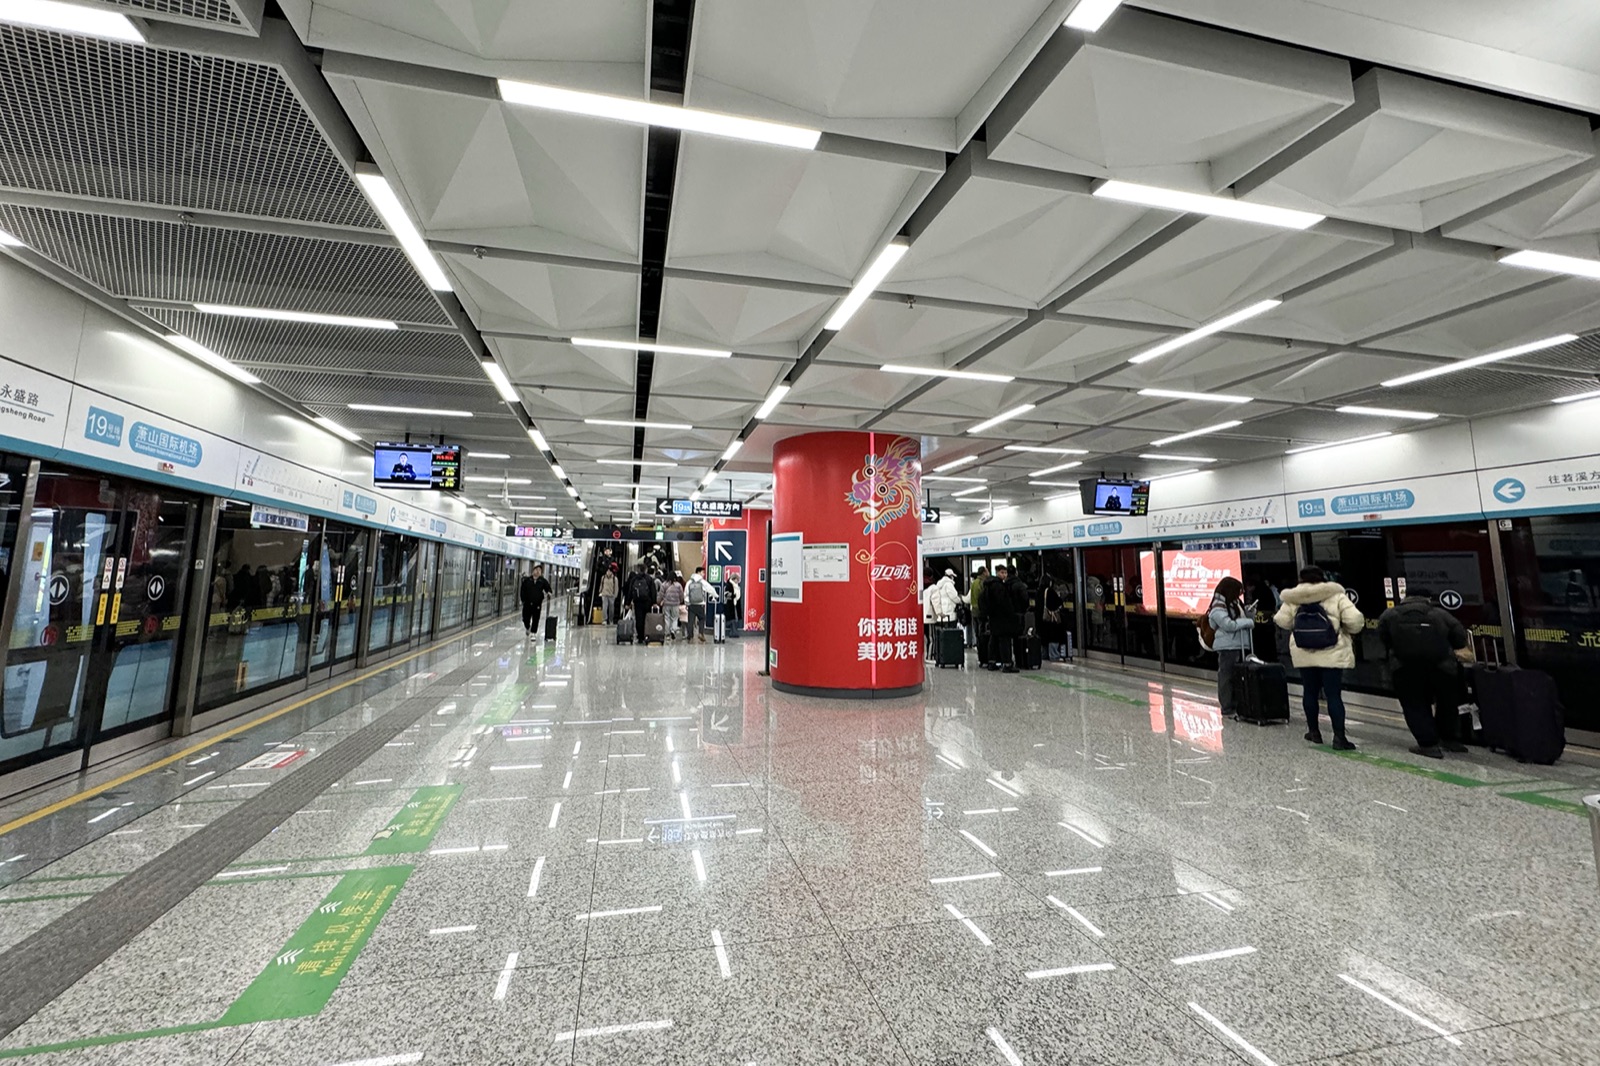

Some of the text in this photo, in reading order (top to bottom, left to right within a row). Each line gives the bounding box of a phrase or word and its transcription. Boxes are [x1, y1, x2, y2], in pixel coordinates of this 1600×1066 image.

[0, 383, 39, 407] 永盛路
[0, 405, 46, 423] gsheng Road
[88, 413, 108, 437] 19
[135, 425, 198, 457] 萧山国际机场
[1299, 502, 1313, 515] 19
[1337, 490, 1407, 508] 萧山国际机场
[1500, 519, 1506, 528] 6
[871, 563, 912, 580] 可口可乐
[857, 617, 918, 638] 你我相连
[857, 640, 918, 662] 美妙龙年
[293, 890, 376, 975] 请排队候车
[319, 954, 344, 978] Wait
